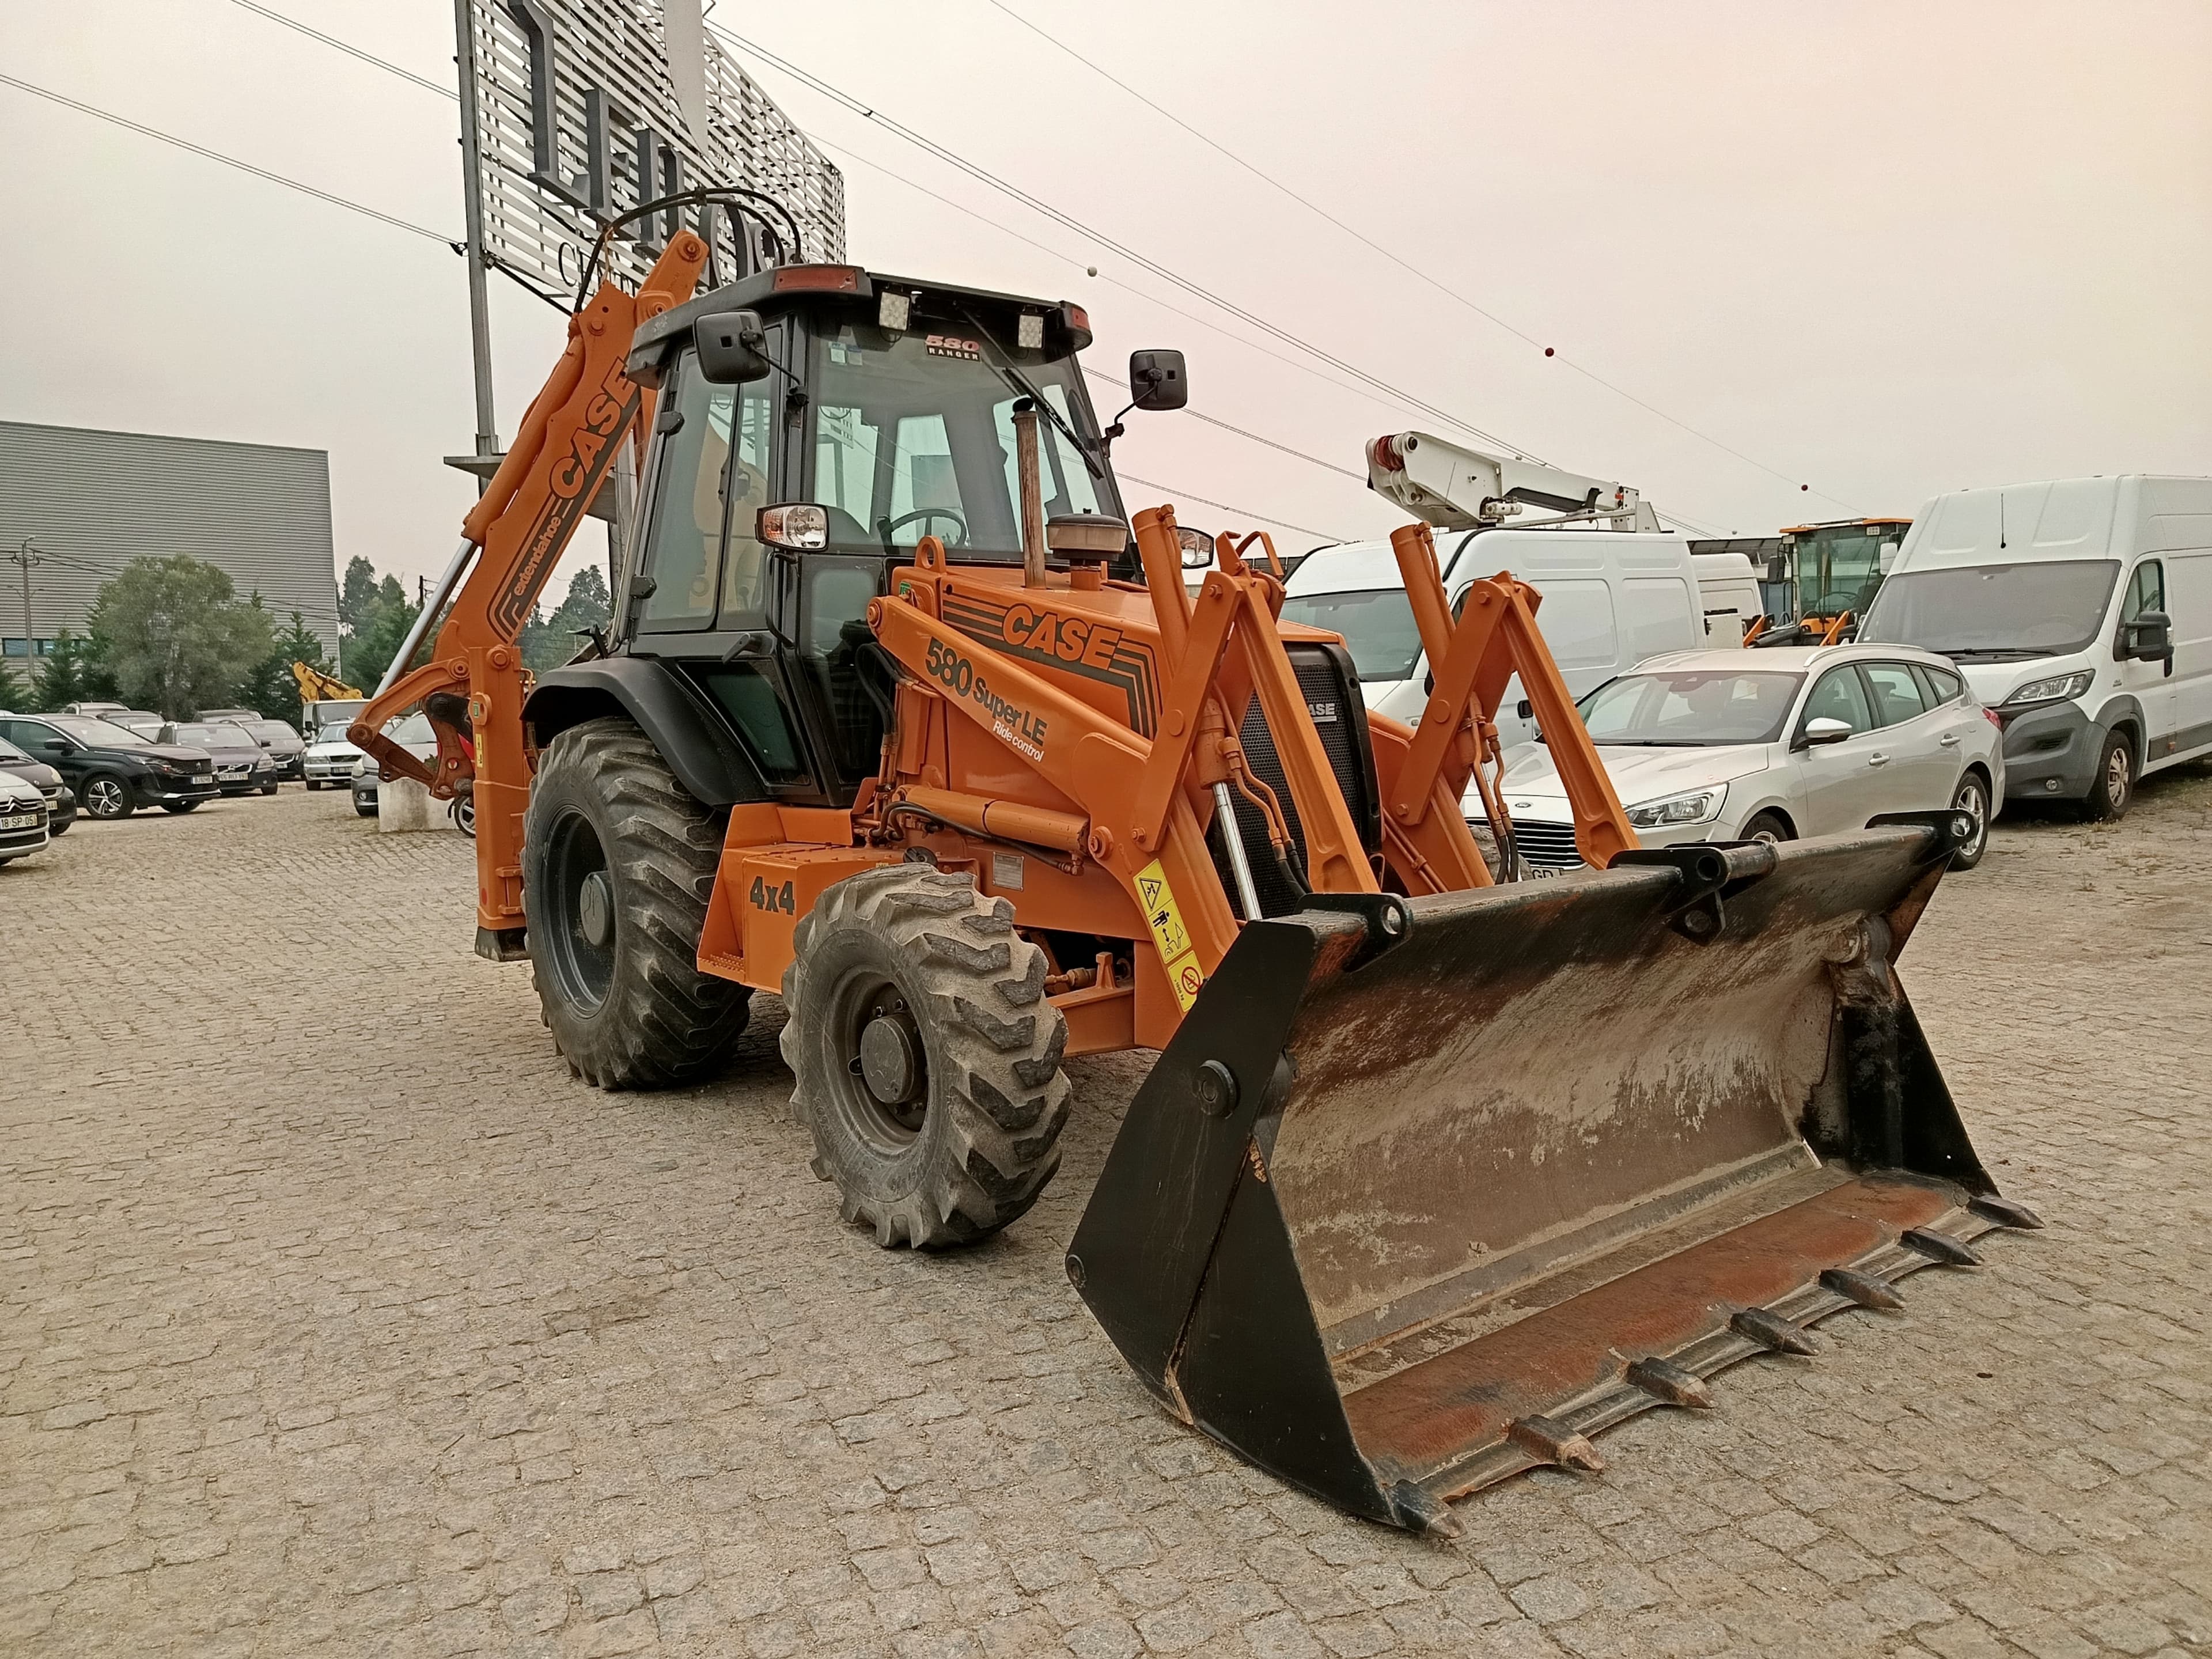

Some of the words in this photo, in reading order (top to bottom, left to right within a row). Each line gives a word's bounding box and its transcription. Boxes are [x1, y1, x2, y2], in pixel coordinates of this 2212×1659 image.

[925, 335, 979, 351] 580
[929, 347, 978, 360] RANGER
[550, 357, 637, 499] CASE
[513, 516, 562, 597] extendahoe
[1003, 604, 1123, 671] CASE
[925, 636, 972, 696] 580
[974, 677, 1022, 728] Super
[1021, 710, 1047, 747] LE
[1308, 703, 1335, 715] ASE
[993, 721, 1013, 741] Ride
[1012, 736, 1044, 762] control
[750, 876, 795, 916] 4x4
